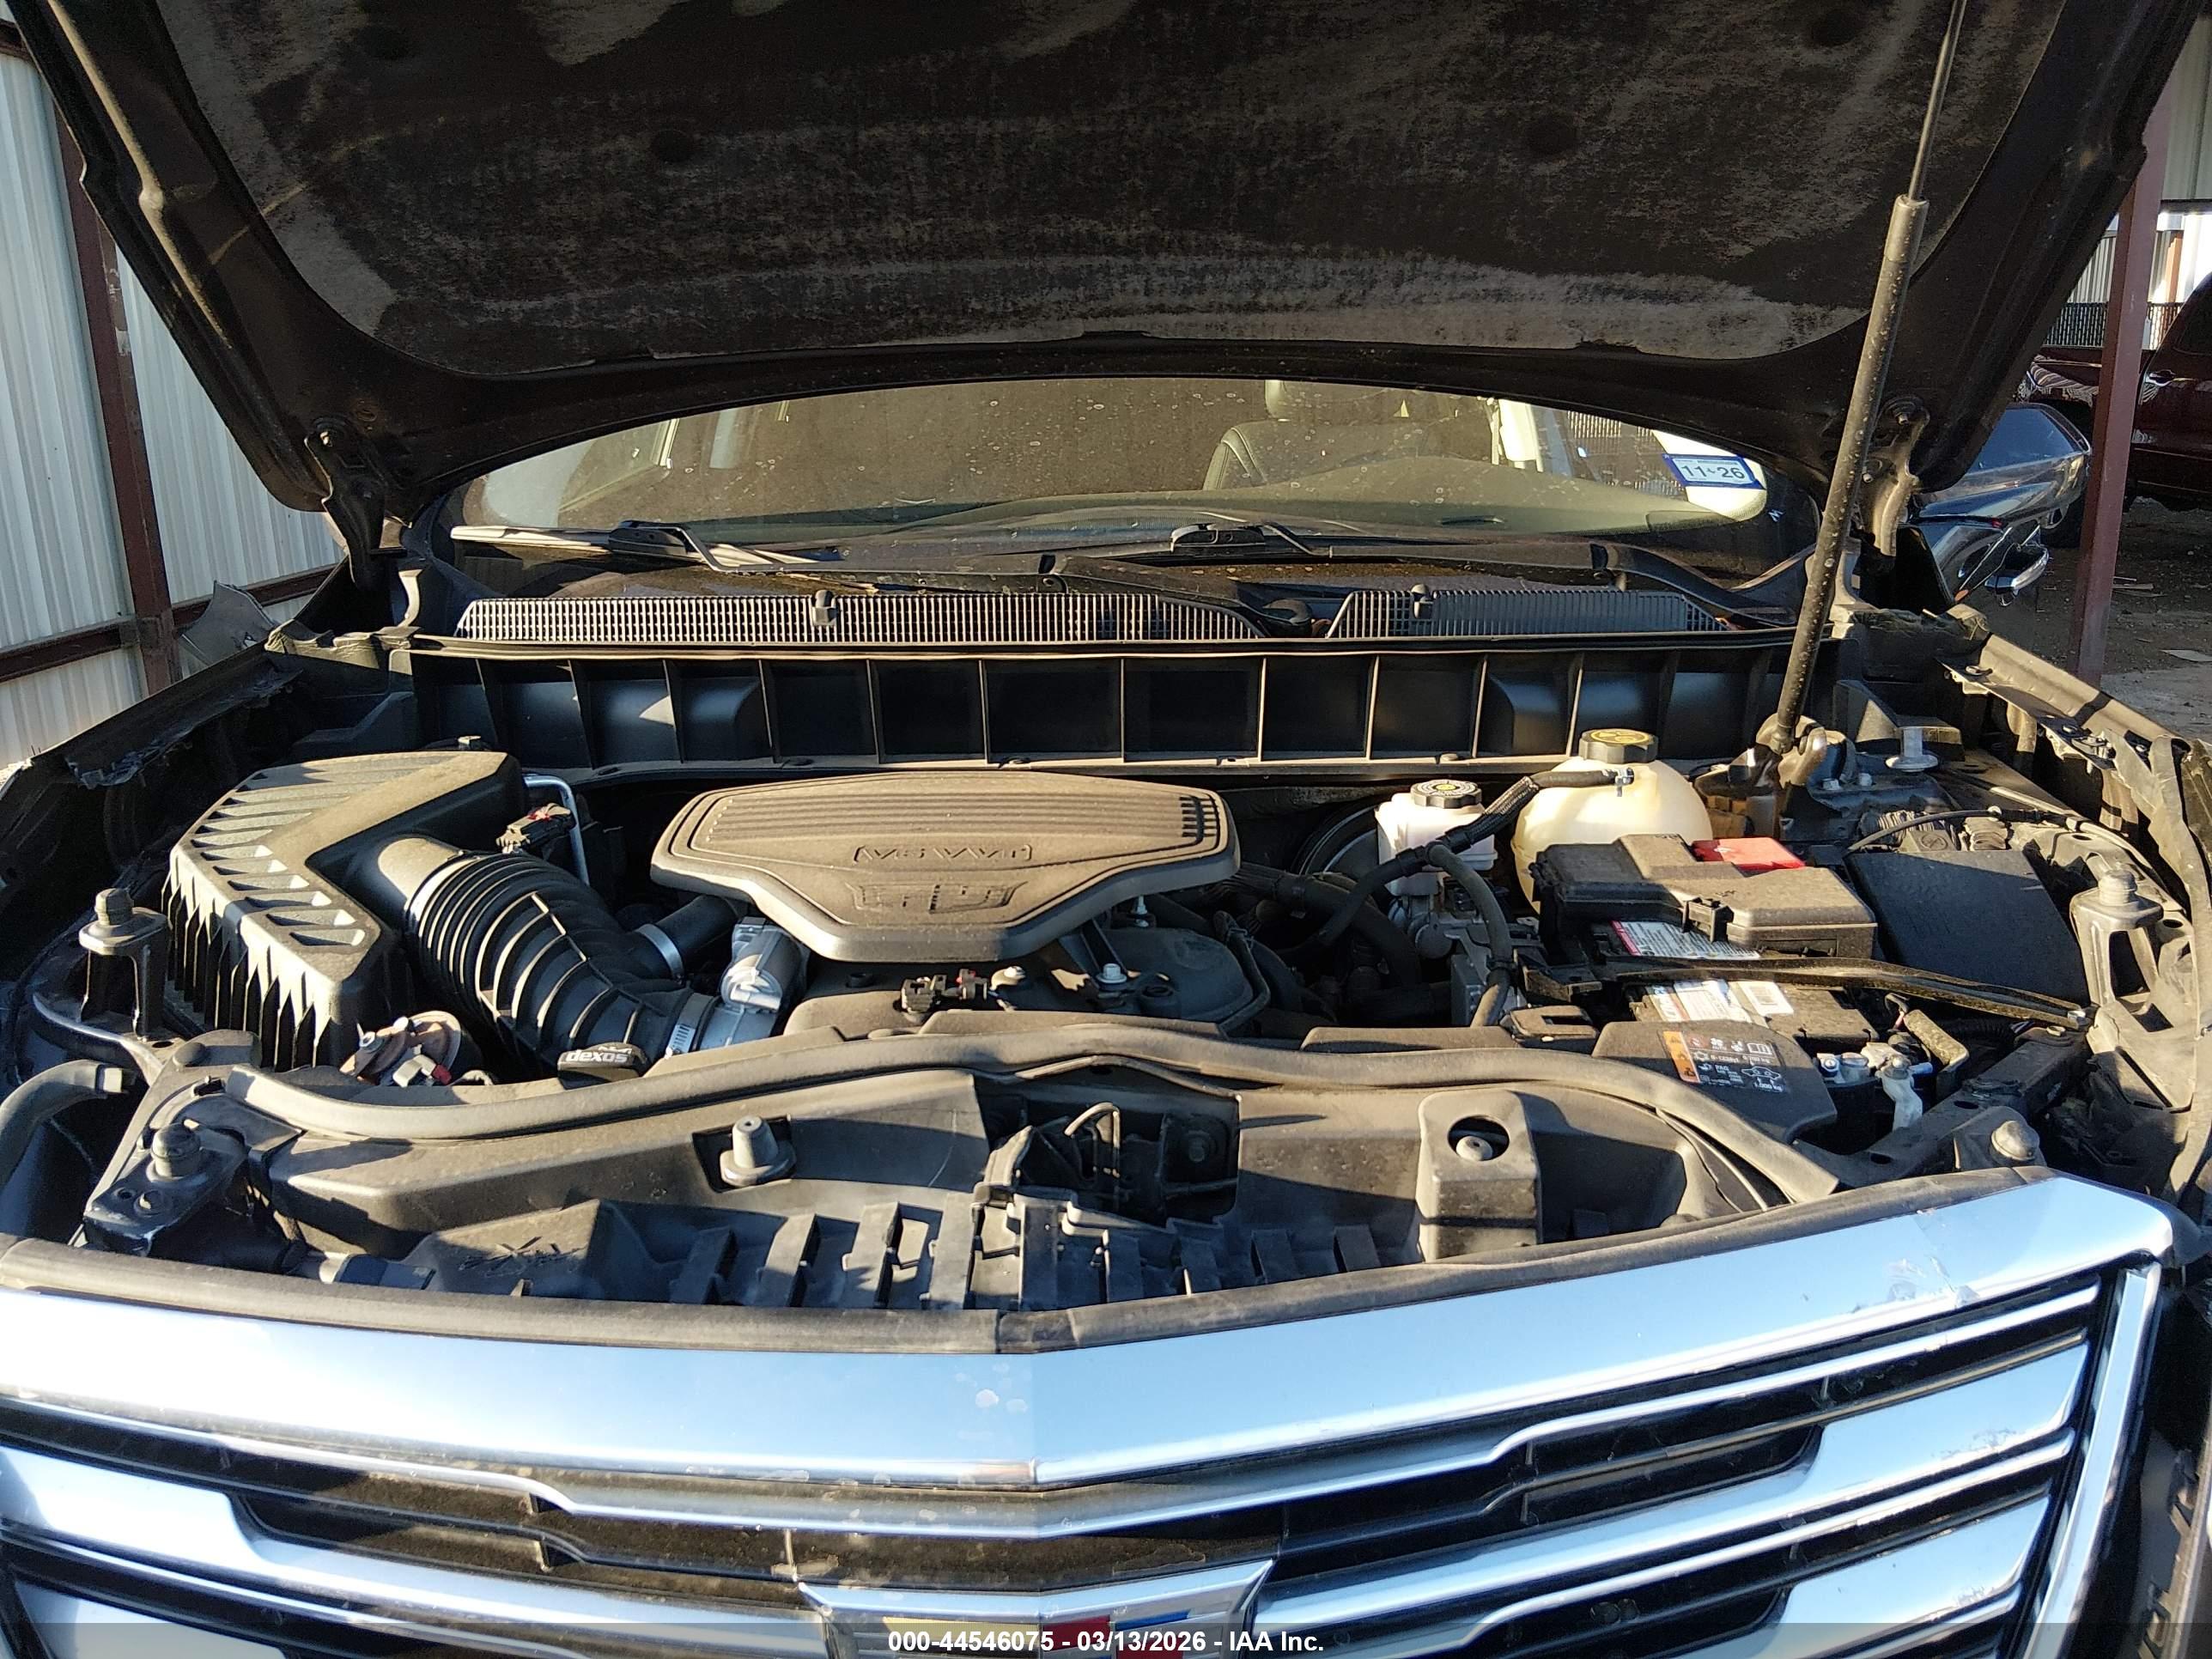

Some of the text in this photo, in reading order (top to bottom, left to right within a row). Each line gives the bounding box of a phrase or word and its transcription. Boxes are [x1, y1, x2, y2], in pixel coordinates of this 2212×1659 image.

[1681, 465, 1745, 479] 11 26
[565, 1049, 629, 1063] dexos
